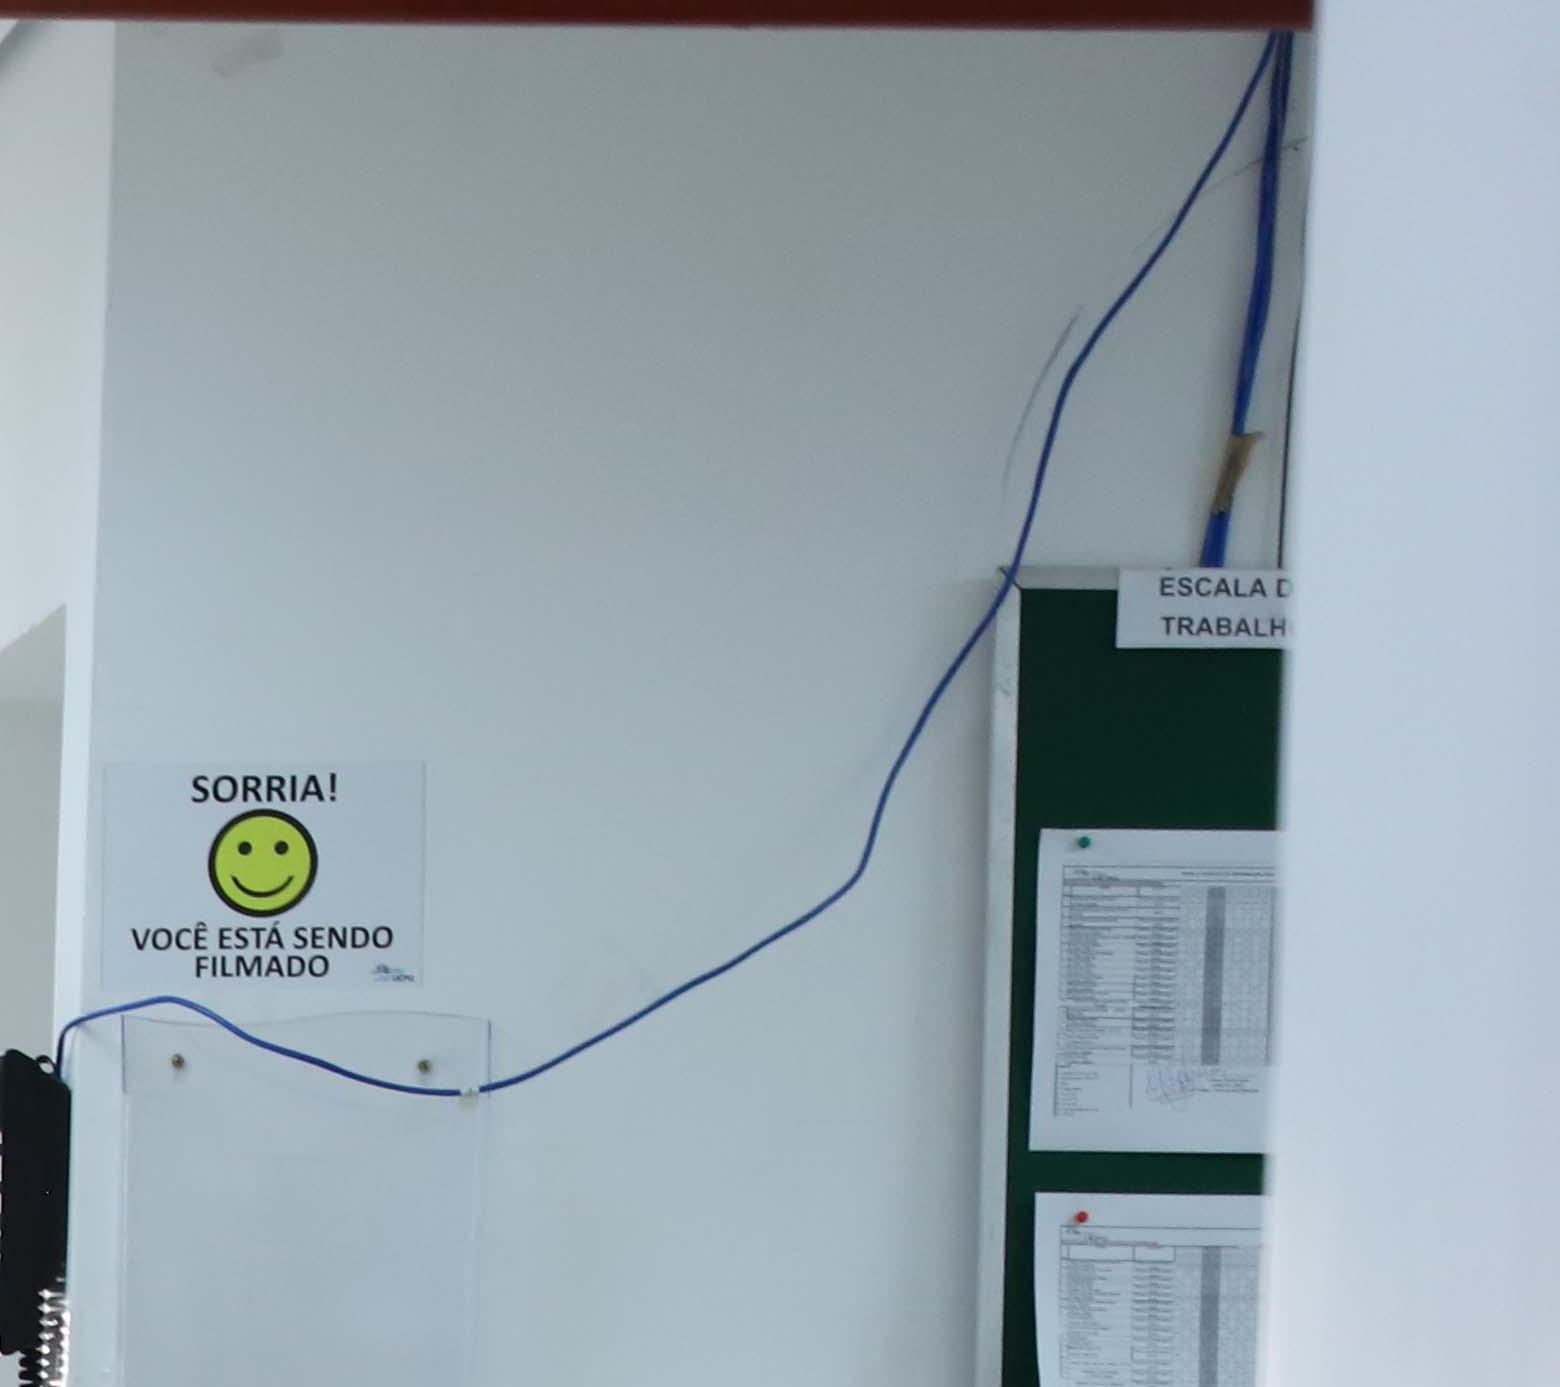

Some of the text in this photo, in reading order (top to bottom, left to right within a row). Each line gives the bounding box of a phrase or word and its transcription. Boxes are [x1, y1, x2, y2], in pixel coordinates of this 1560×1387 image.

[1160, 576, 1267, 598] ESCALA
[1161, 616, 1290, 638] TRABALH
[191, 772, 338, 803] SORRIA!
[131, 920, 395, 951] VOCÊ ESTÁ SENDO
[194, 954, 330, 979] FILMADO
